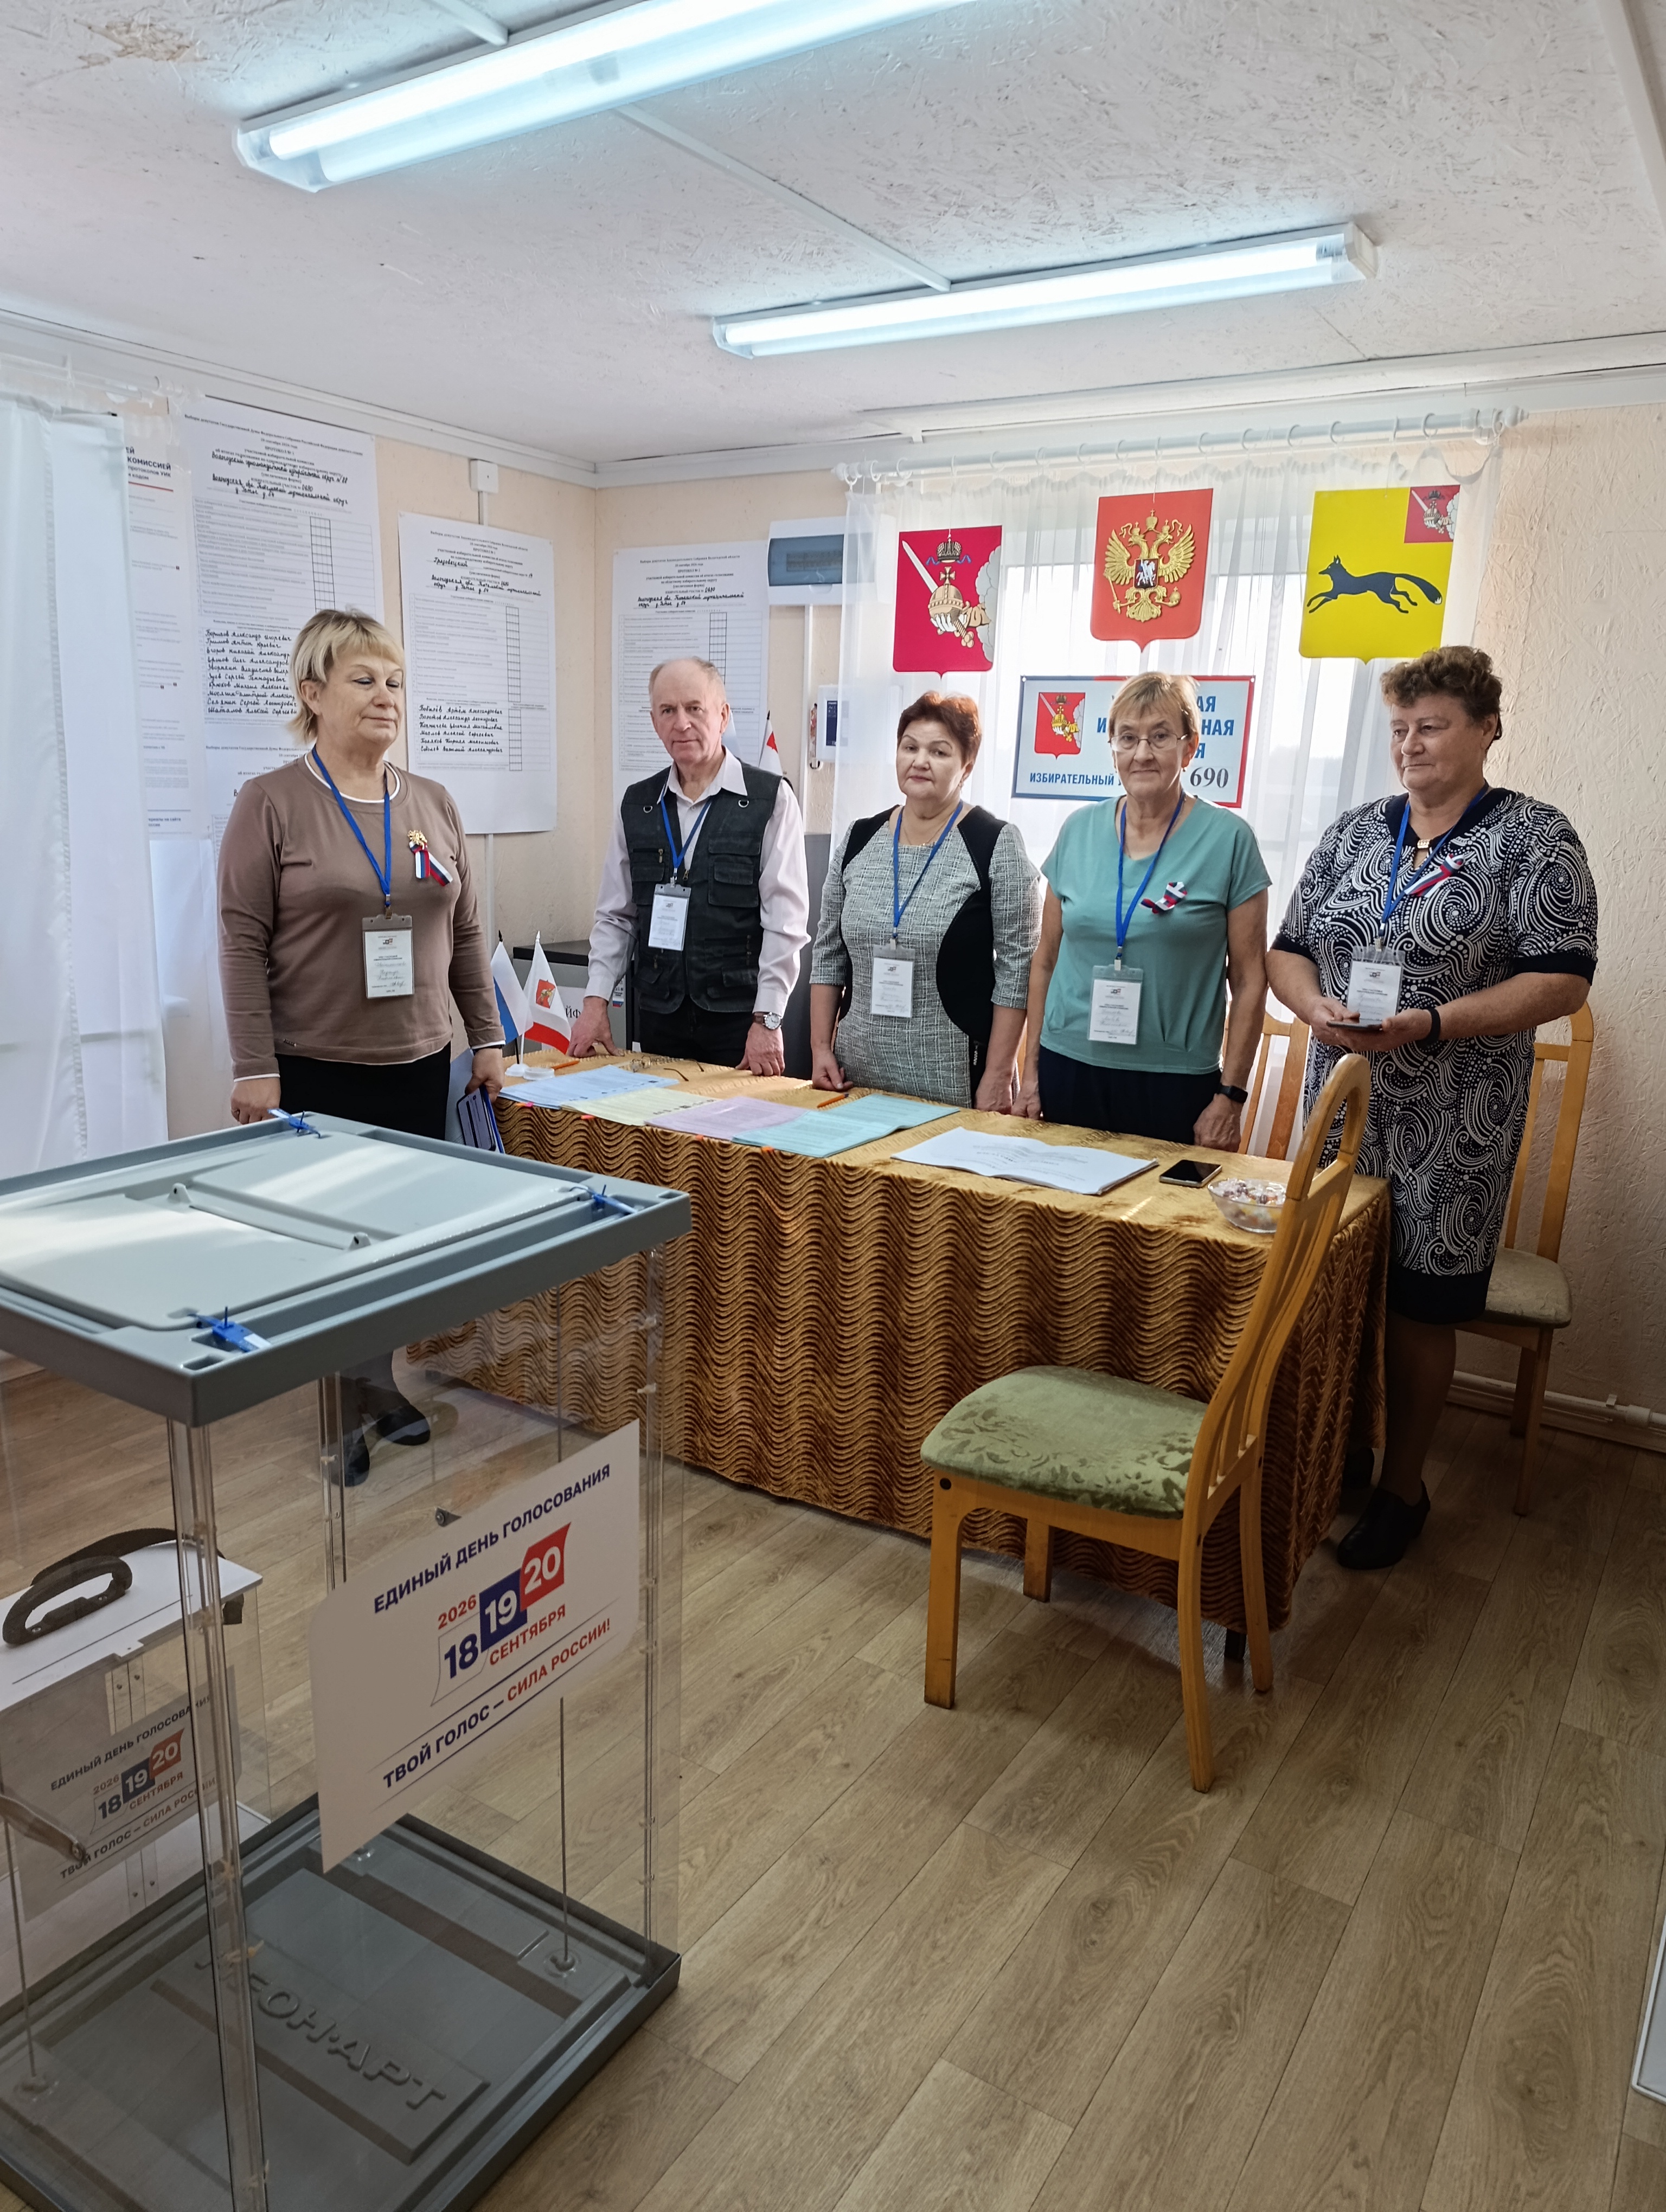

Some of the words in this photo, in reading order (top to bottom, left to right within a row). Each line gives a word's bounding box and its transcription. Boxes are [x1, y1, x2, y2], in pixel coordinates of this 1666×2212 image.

[127, 456, 171, 471] КОМИССИЕЙ
[231, 632, 261, 641] Александр
[249, 658, 289, 668] Александров
[258, 651, 290, 660] Александр
[1030, 772, 1114, 786] ИЗБИРАТЕЛЬНЫЙ
[1190, 767, 1229, 788] 690
[566, 1005, 581, 1018] ЙФ
[374, 1556, 452, 1614] ЕДИНЫЙ
[455, 1531, 499, 1568] ДЕНЬ
[502, 1463, 611, 1539] ГОЛОСОВАНИЯ
[438, 1594, 477, 1630] 2026
[444, 1634, 479, 1679] 18
[485, 1590, 517, 1634] 19
[525, 1545, 561, 1596] 20
[489, 1604, 566, 1666] СЕНТЯБРЯ
[383, 1743, 432, 1789] ТВОЙ
[435, 1704, 490, 1755] ГОЛОС
[507, 1663, 548, 1702] СИЛА
[551, 1618, 611, 1671] РОССИИ!
[50, 1754, 101, 1791] ЕДИНЫЙ
[104, 1740, 134, 1763] ДЕНЬ
[98, 1795, 122, 1819] 18
[125, 1769, 148, 1793] 19
[152, 1741, 178, 1771] 20
[93, 1773, 119, 1795] 2026
[130, 1771, 183, 1810] СЕНТЯБРЯ
[94, 1830, 131, 1859] ГОЛОС
[143, 1805, 172, 1827] СИЛА
